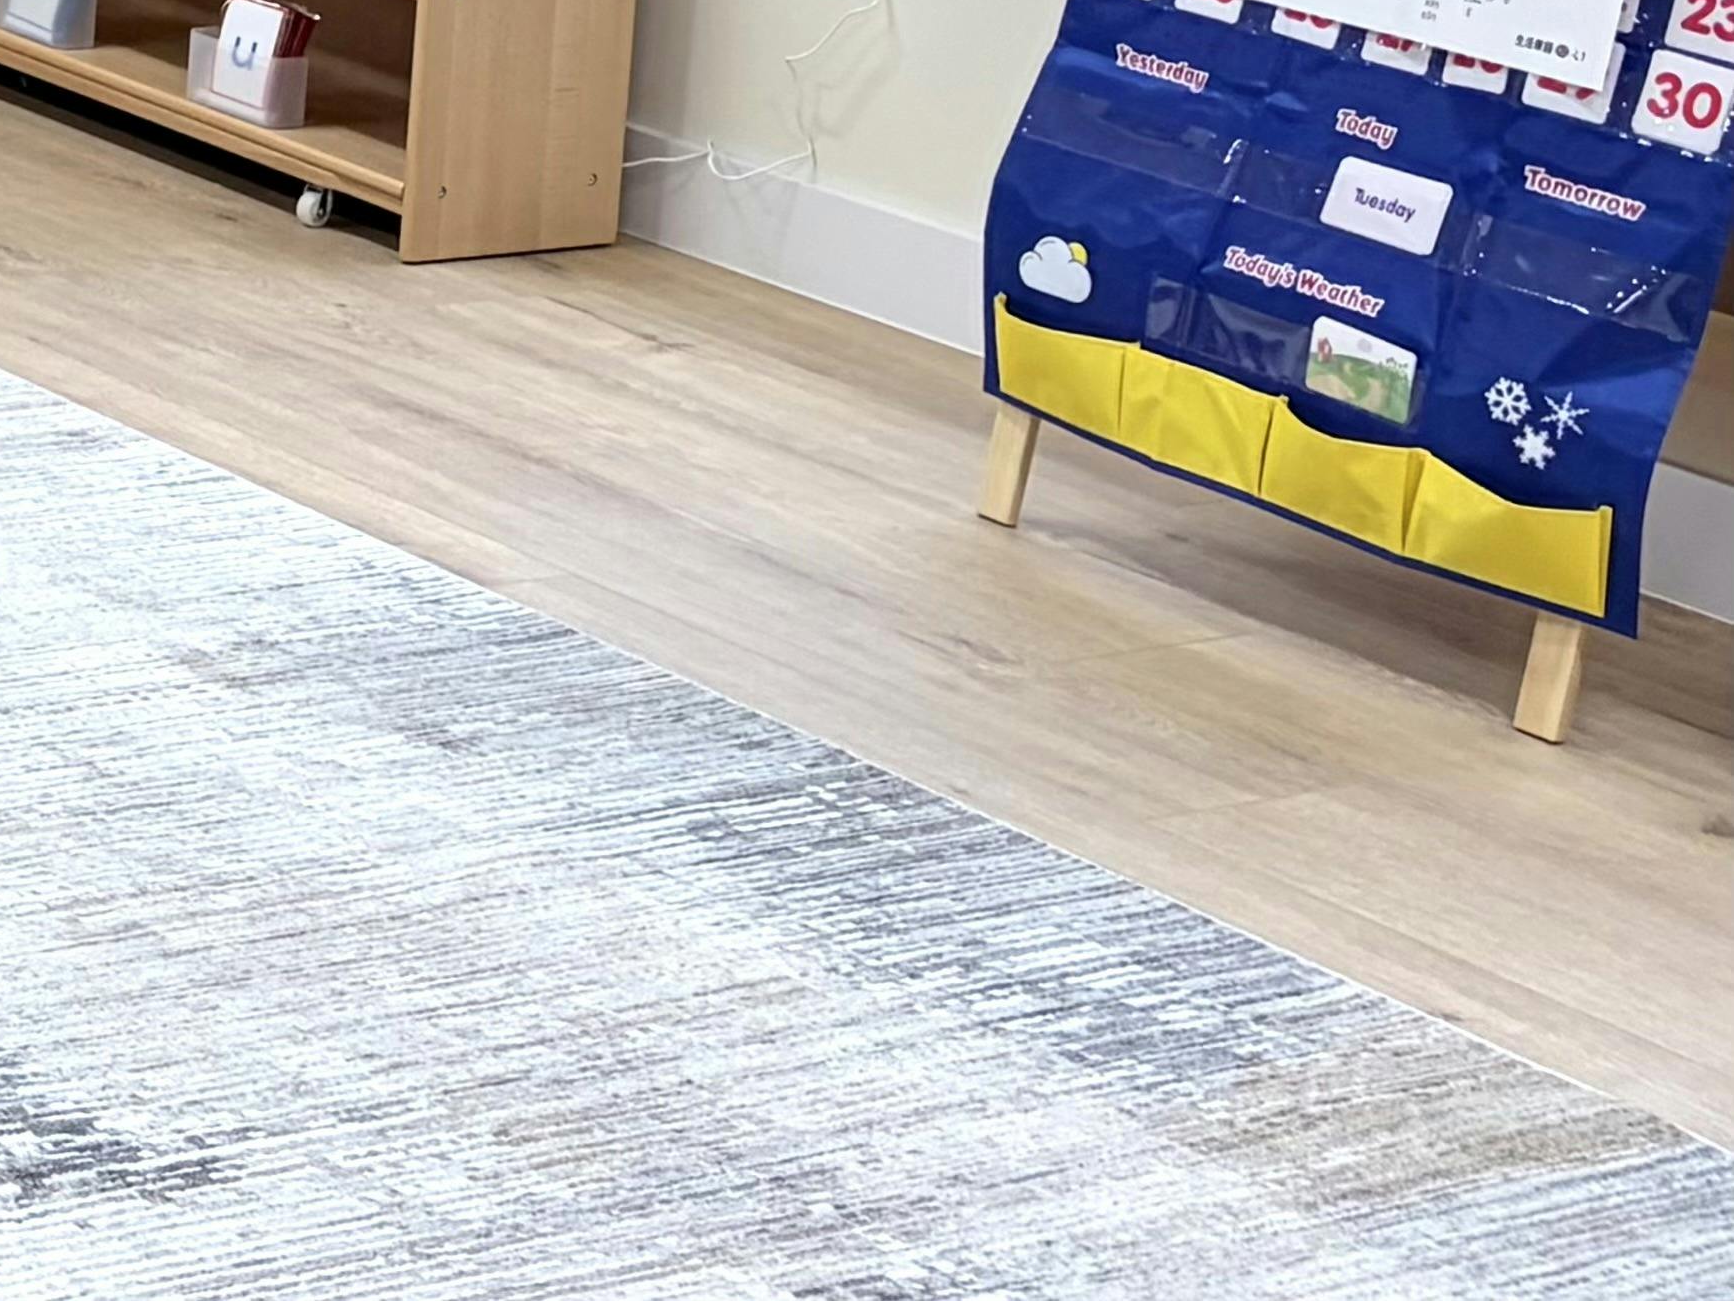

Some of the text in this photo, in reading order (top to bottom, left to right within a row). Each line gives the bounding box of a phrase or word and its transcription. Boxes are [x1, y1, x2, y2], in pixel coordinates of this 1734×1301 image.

[231, 35, 260, 72] u
[1116, 43, 1210, 93] Yesterday
[1646, 71, 1722, 129] 30
[1335, 108, 1398, 150] Today
[1354, 187, 1416, 223] Tuesday
[1524, 165, 1647, 223] Tomorrow
[1223, 245, 1385, 318] Today's Weather
